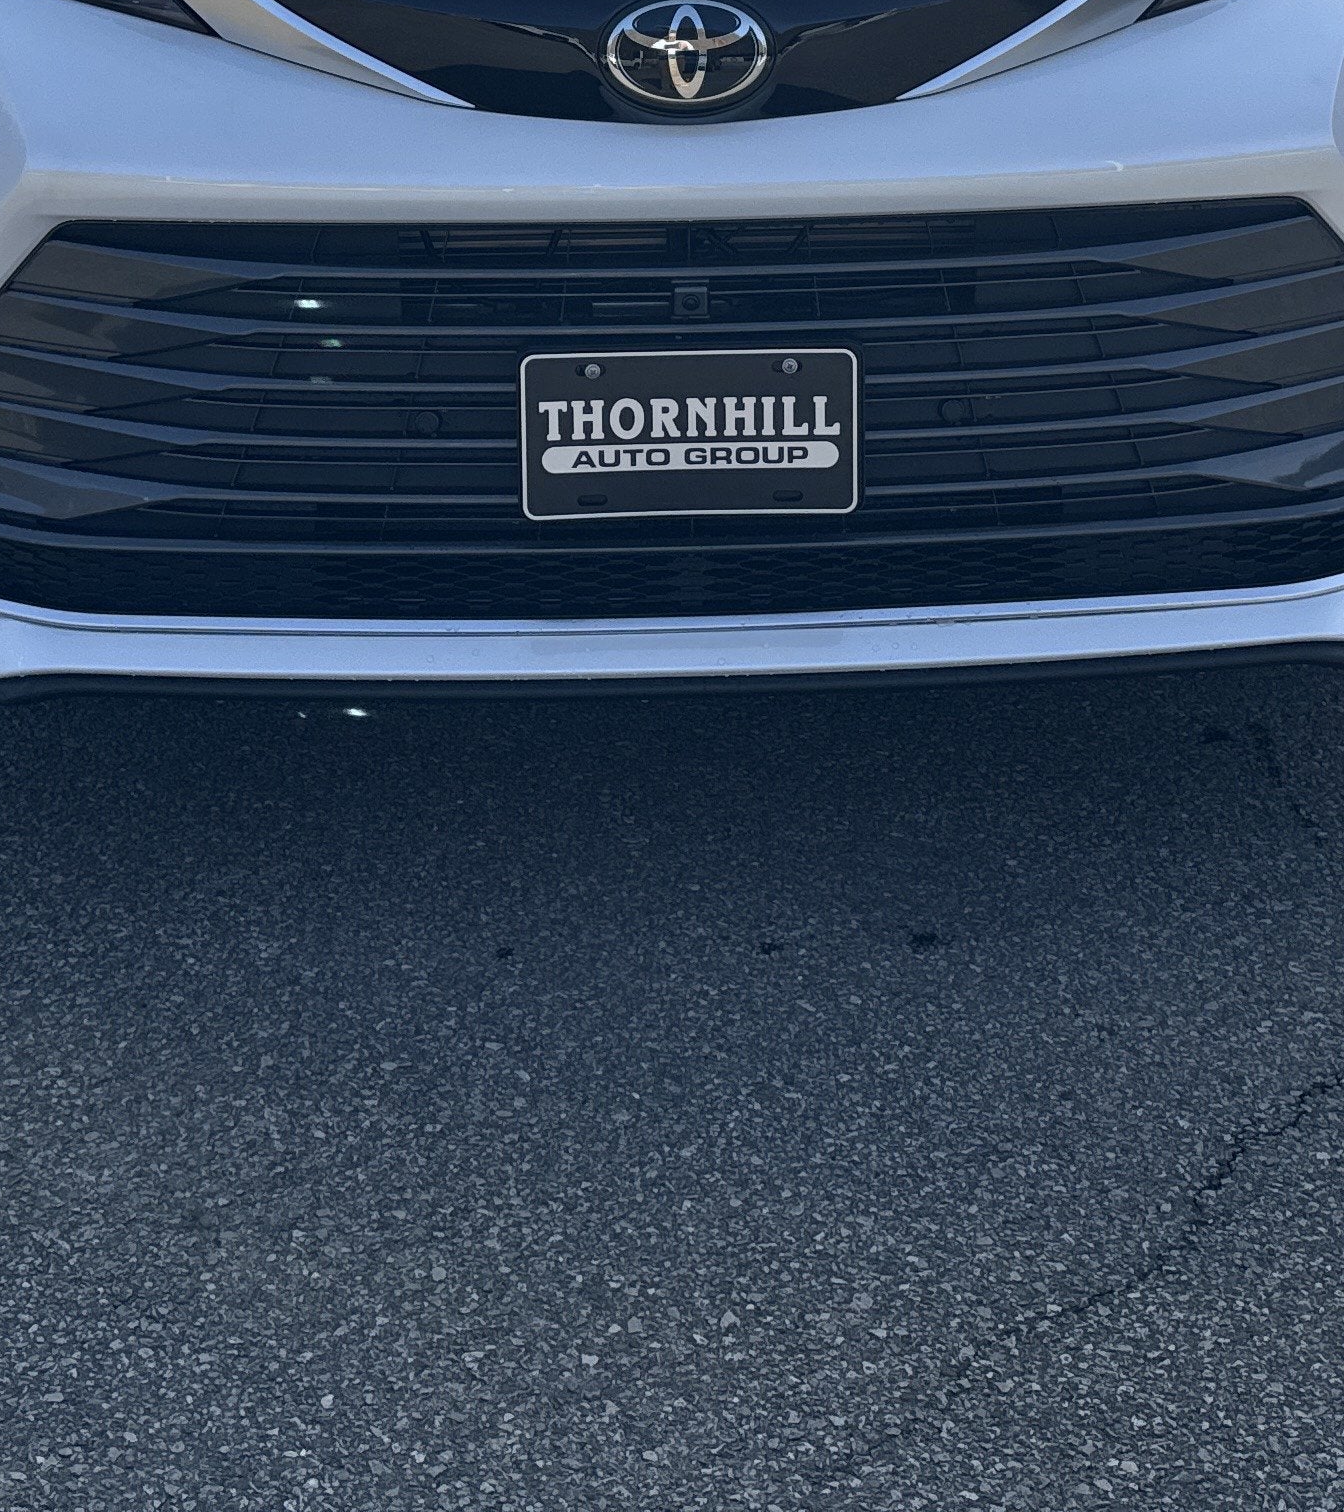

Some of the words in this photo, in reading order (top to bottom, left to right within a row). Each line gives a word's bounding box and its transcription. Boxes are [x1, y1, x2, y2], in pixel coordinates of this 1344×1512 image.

[538, 395, 841, 441] THORNHILL
[571, 448, 671, 469] AUTO
[684, 446, 809, 465] GROUP
